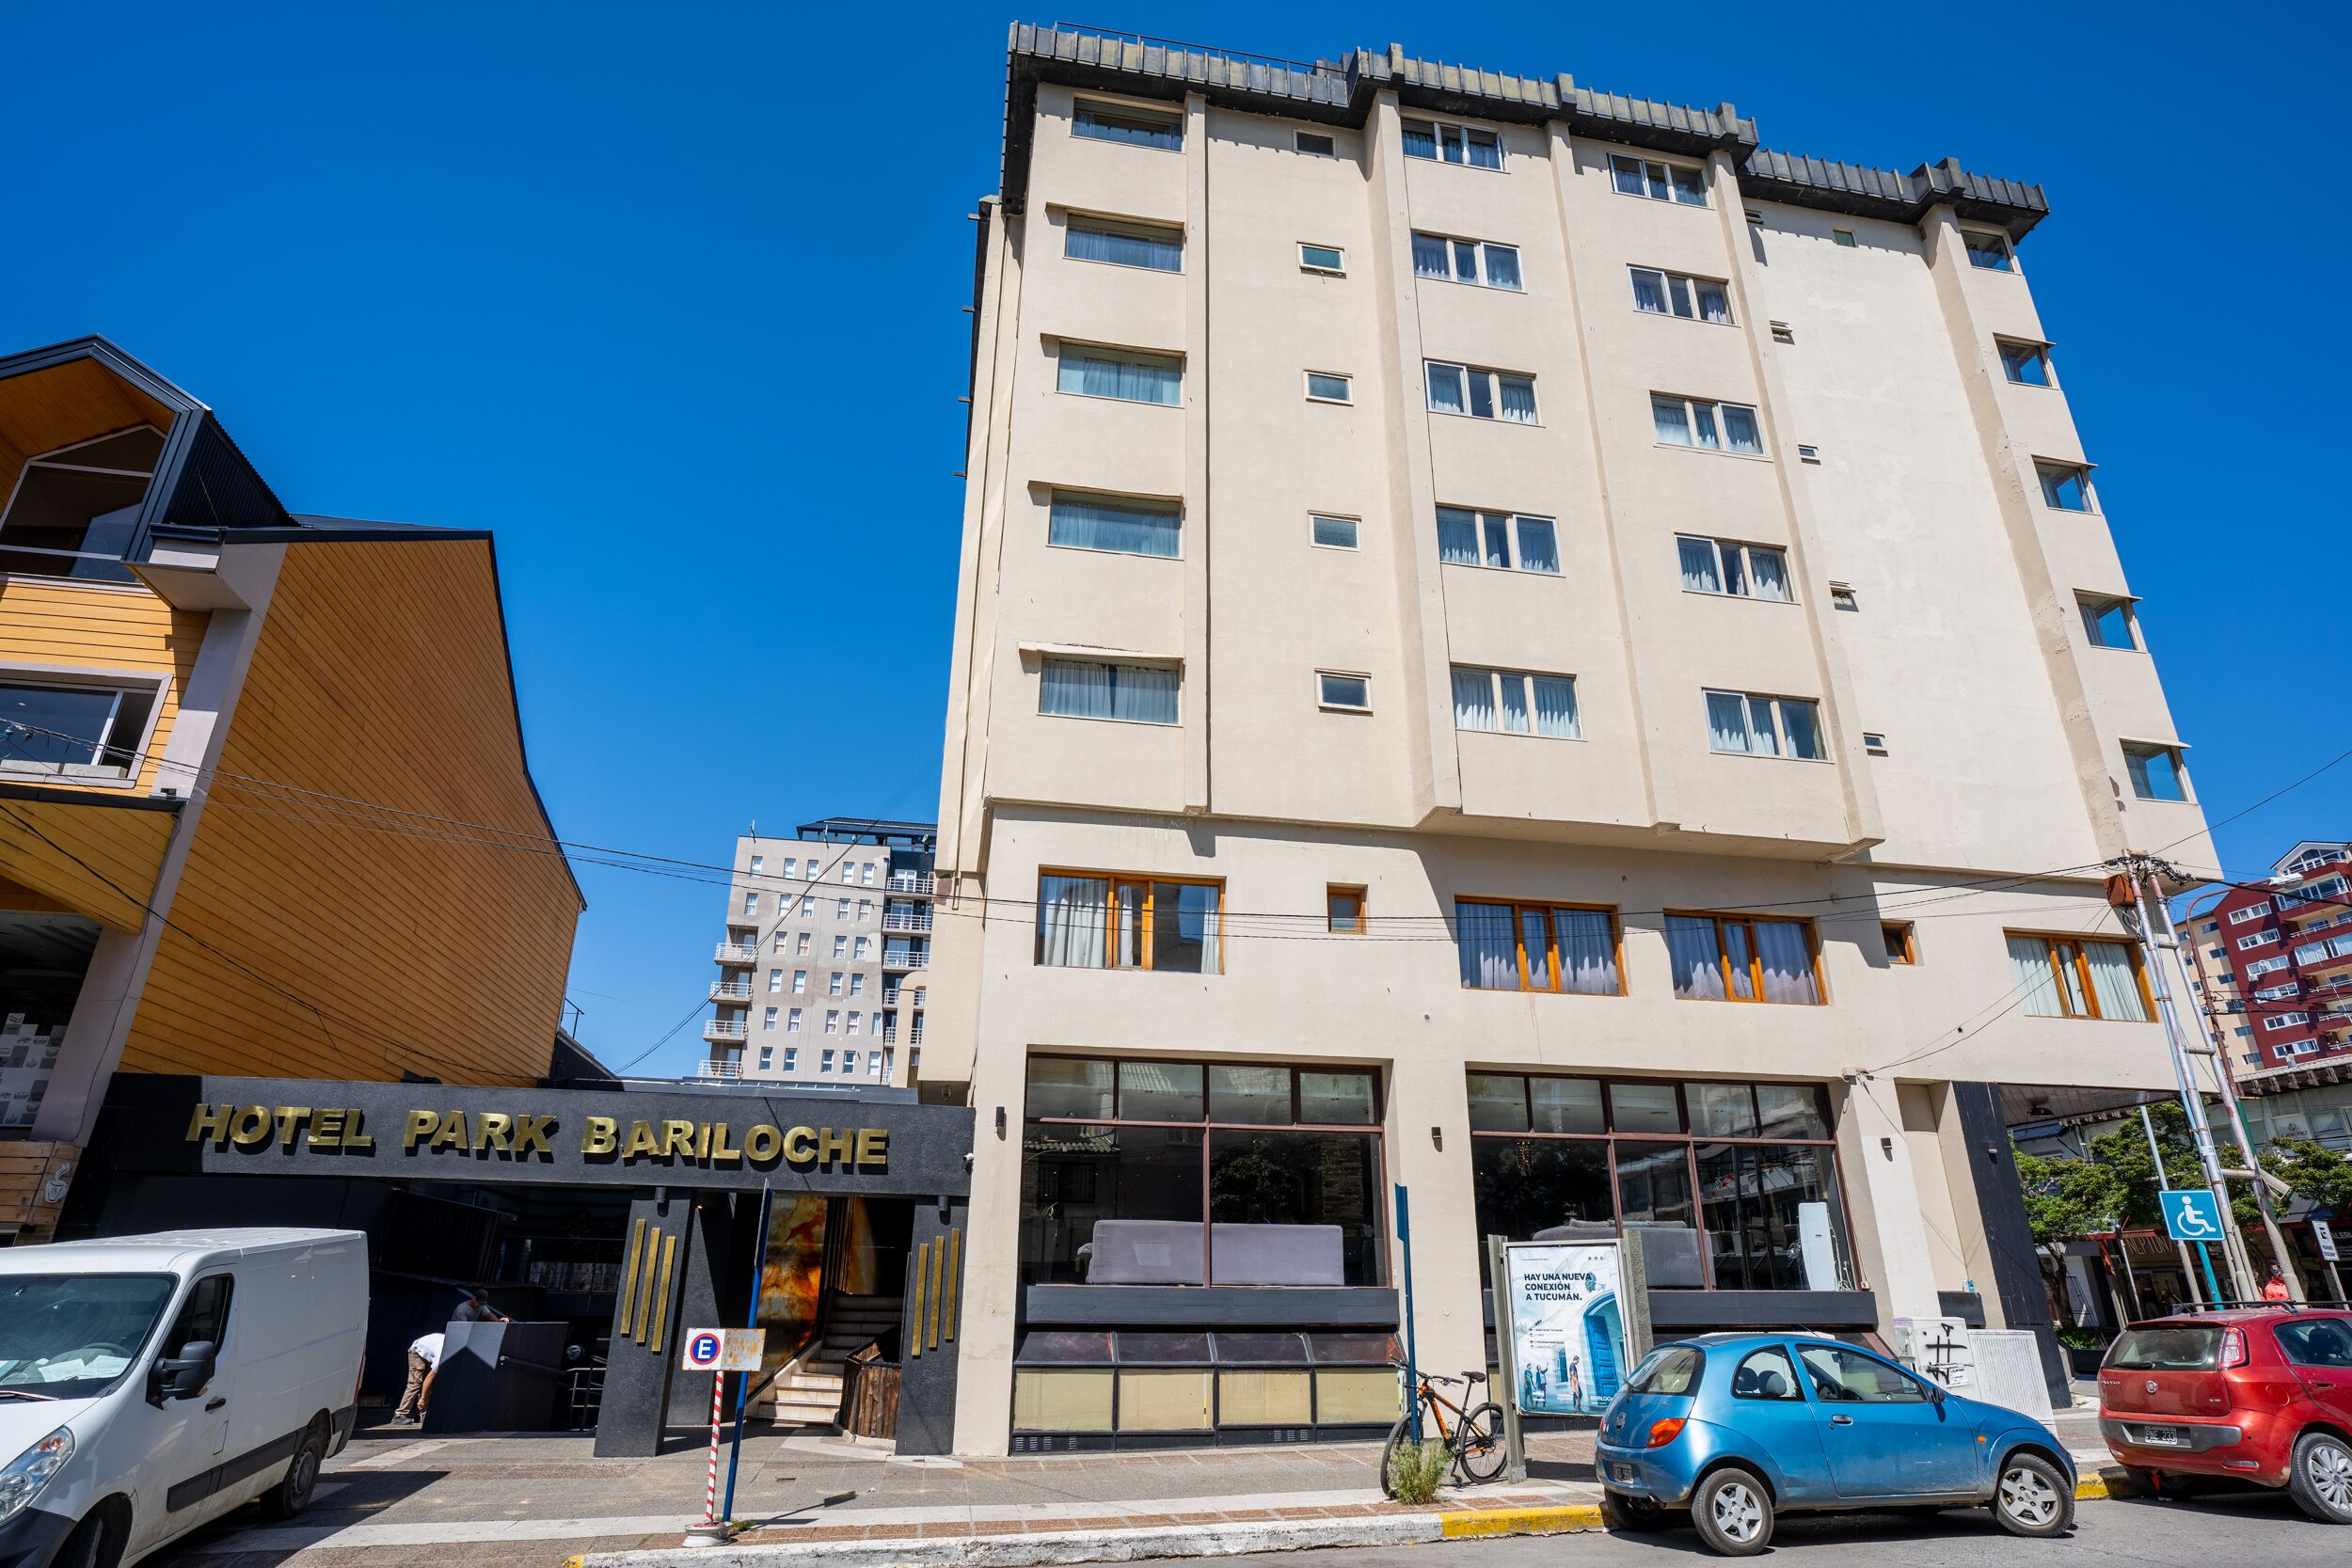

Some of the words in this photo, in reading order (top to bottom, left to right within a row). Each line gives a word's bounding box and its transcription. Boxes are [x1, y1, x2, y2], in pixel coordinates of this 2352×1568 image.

[184, 1103, 373, 1148] HOTEL
[401, 1110, 557, 1152] PARK
[580, 1116, 888, 1164] BARILOCHE
[1524, 1273, 1541, 1281] HAY
[1543, 1273, 1562, 1281] UNA
[1563, 1273, 1592, 1281] NUEVA
[1525, 1281, 1570, 1291] CONEXIÓN
[1534, 1291, 1582, 1300] TUCUMÁN.
[697, 1339, 712, 1359] E
